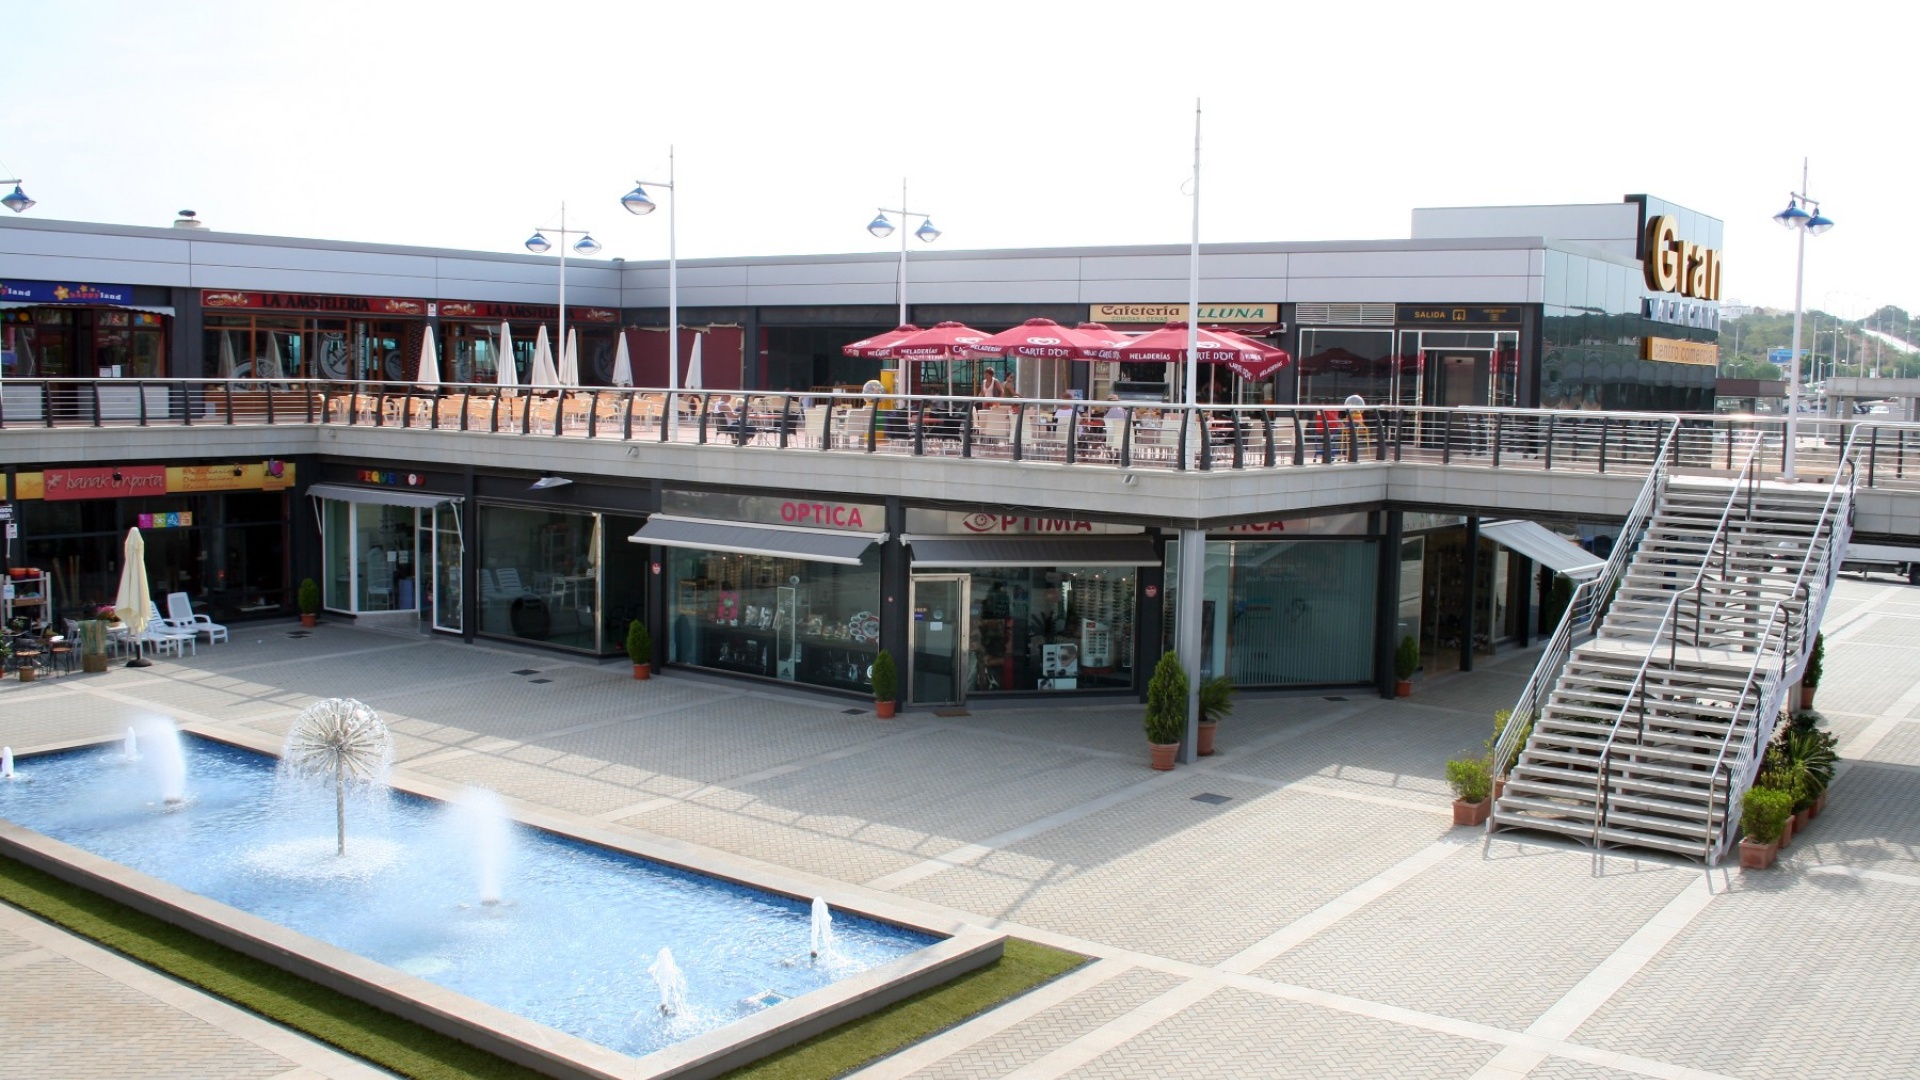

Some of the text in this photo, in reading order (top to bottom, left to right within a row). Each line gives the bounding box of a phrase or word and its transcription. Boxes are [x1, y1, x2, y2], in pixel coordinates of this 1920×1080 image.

[1651, 214, 1722, 301] Gran
[262, 293, 370, 312] LA AMSTELERIA
[1101, 306, 1181, 317] Cafetería
[1414, 311, 1446, 319] SALIDA
[1018, 346, 1045, 356] CARTE
[1130, 351, 1171, 361] HELADERÍAS
[357, 471, 397, 485] PEQUE
[780, 502, 863, 528] OPTICA
